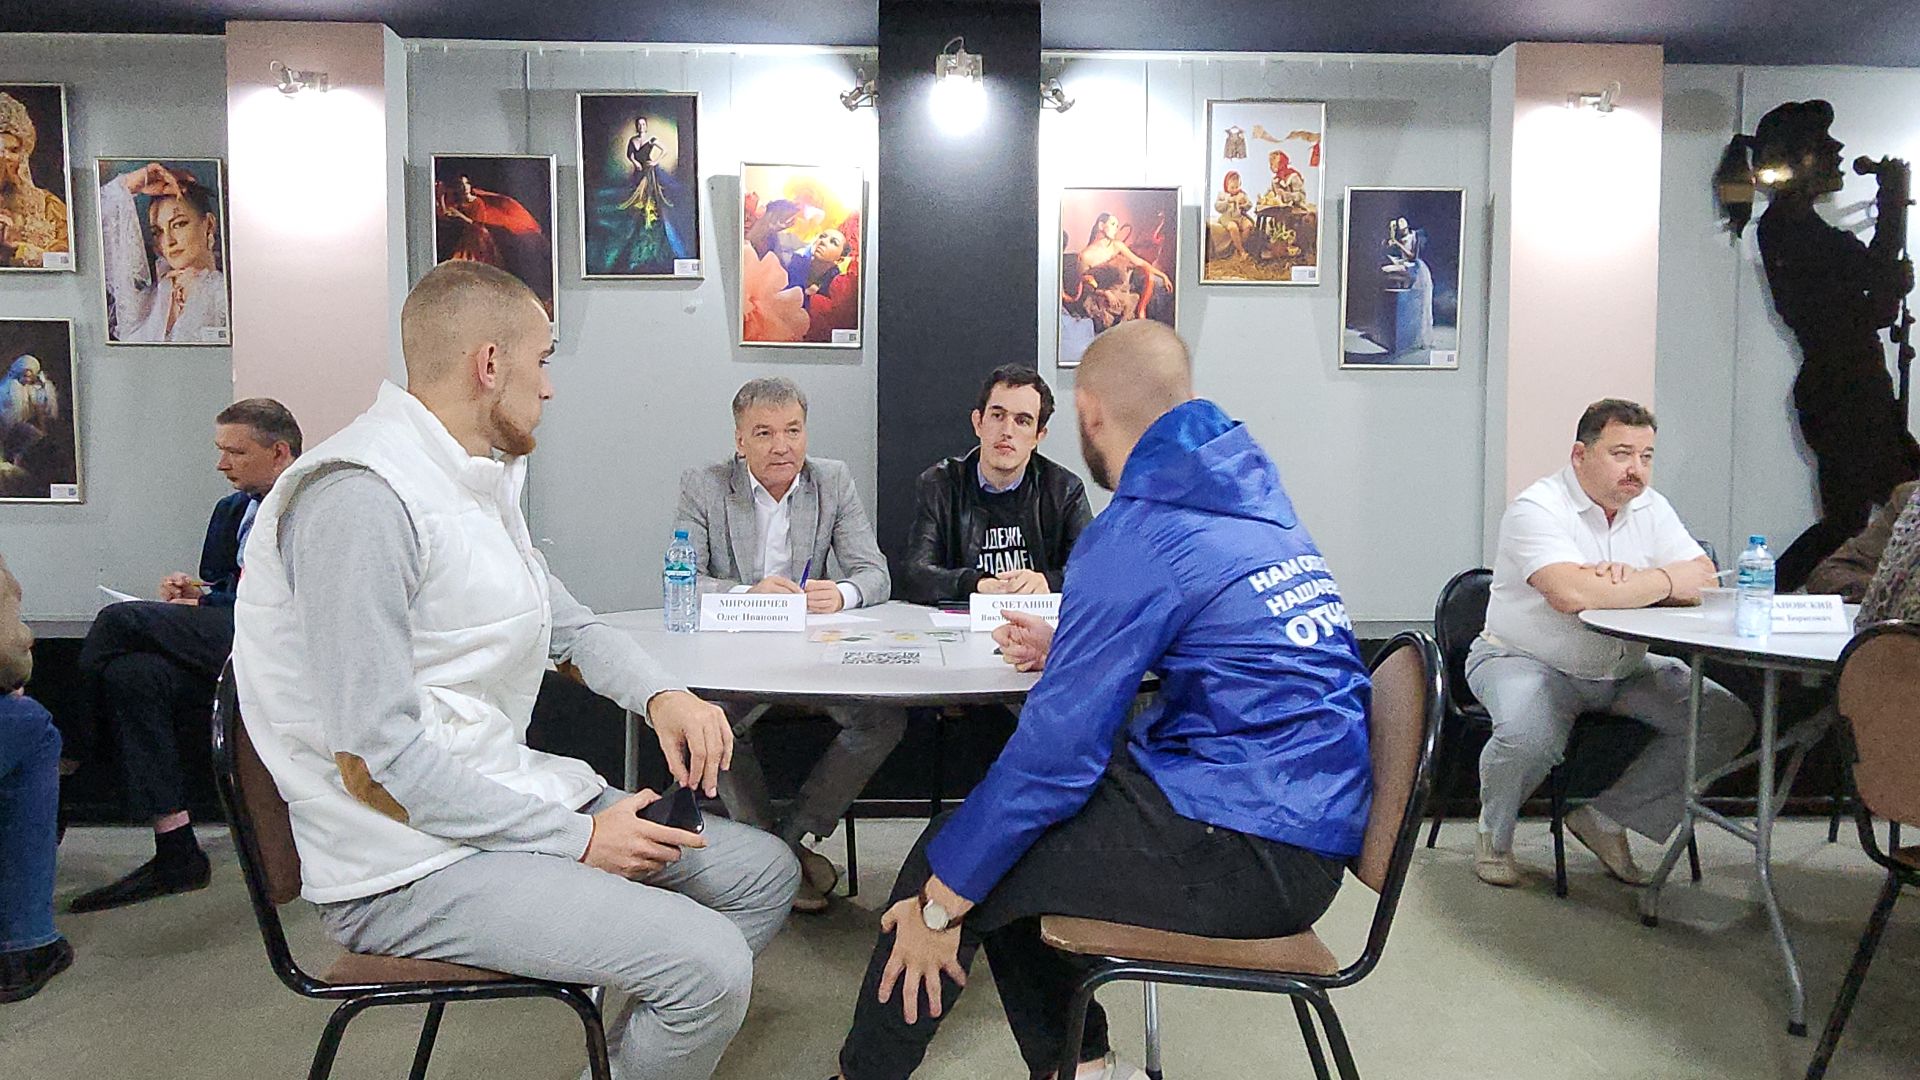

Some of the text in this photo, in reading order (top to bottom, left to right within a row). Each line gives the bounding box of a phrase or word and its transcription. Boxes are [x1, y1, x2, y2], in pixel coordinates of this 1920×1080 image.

[719, 598, 789, 609] МИРОНИЧЕВ
[991, 600, 1054, 609] СМЕТАНИН
[716, 612, 789, 622] Олег Иванович
